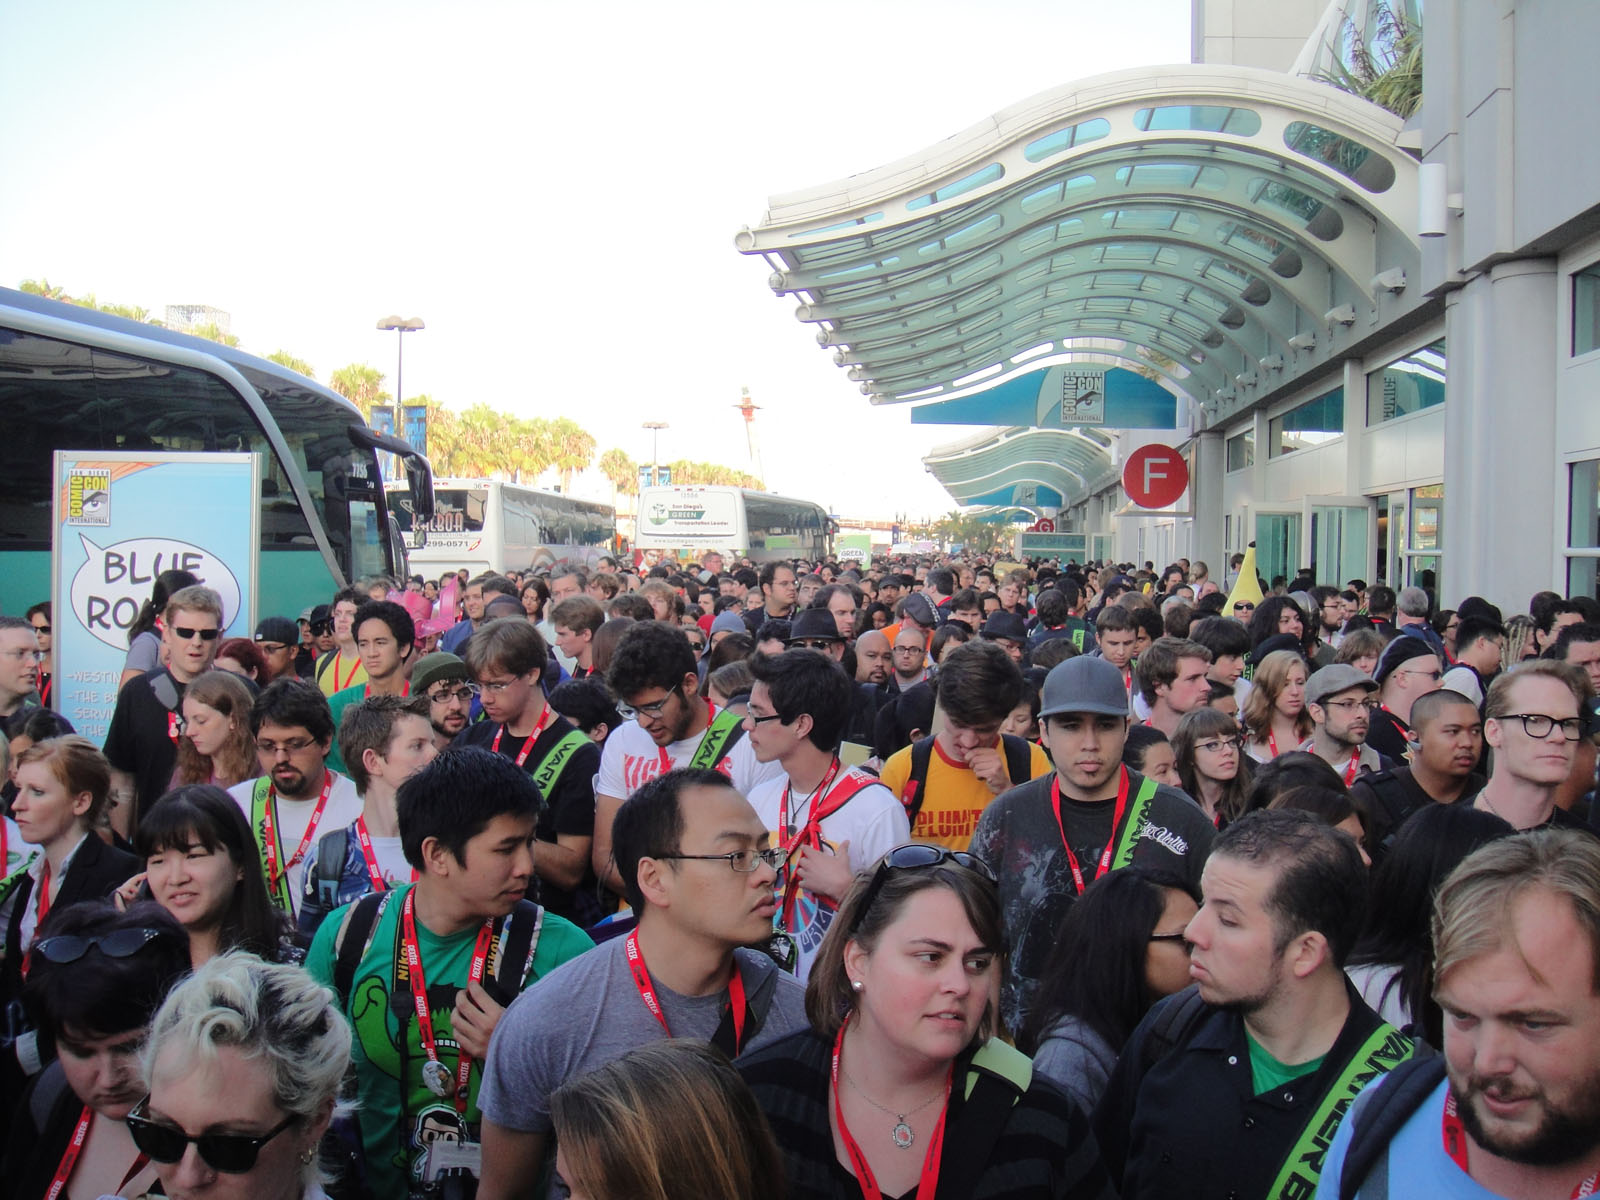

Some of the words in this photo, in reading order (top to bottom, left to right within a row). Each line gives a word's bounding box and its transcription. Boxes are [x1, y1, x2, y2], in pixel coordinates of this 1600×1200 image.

[1077, 377, 1102, 390] CON
[1063, 377, 1077, 415] COMIC
[84, 476, 108, 490] CON
[1144, 458, 1170, 494] F
[70, 476, 83, 517] COMIC
[407, 945, 418, 965] DEXTER
[626, 938, 639, 961] DEXTER
[471, 957, 483, 979] DEXTER
[416, 996, 427, 1017] DEXTER
[643, 991, 660, 1015] DEXTER
[73, 1121, 89, 1147] DEXTER
[48, 1180, 64, 1200] EXTER
